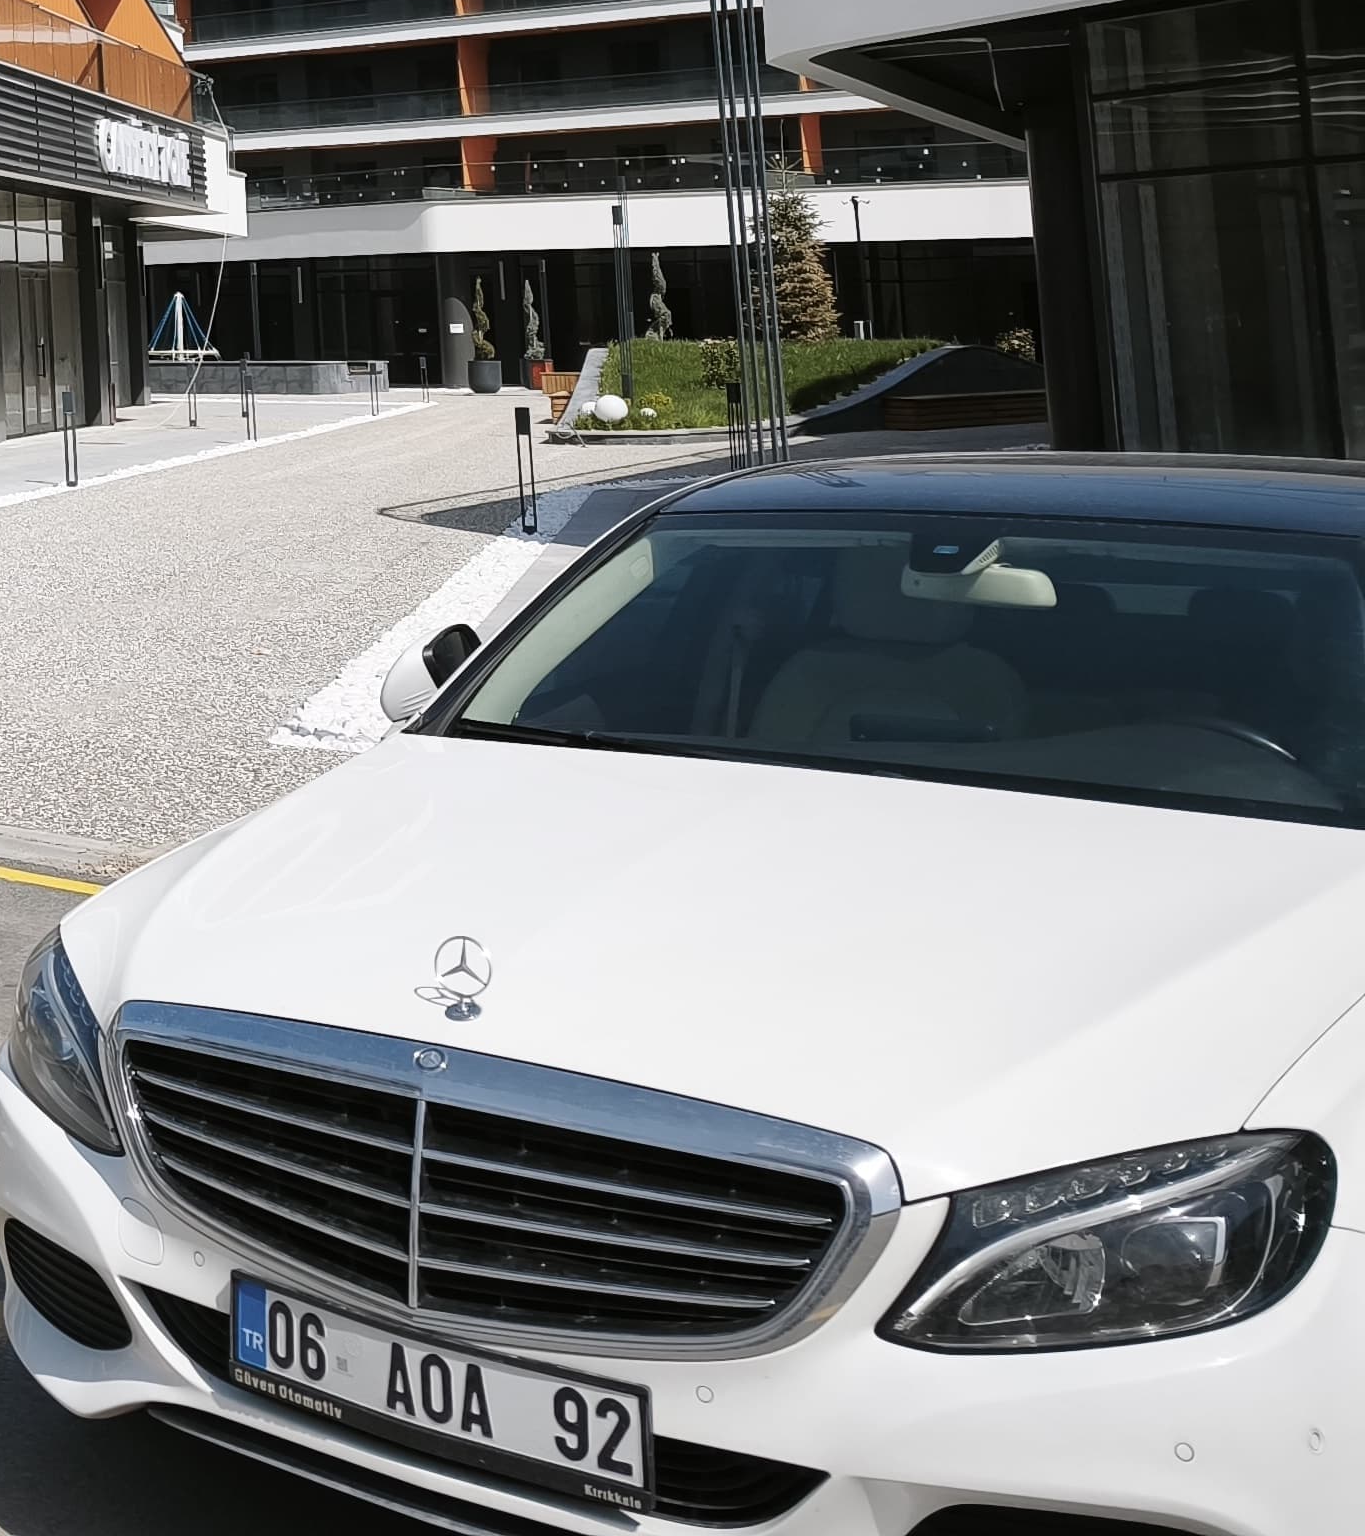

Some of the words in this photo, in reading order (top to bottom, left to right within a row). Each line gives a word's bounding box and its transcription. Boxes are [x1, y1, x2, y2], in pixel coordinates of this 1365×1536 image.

[241, 1327, 264, 1353] TR
[234, 1368, 276, 1395] Güven
[279, 1385, 342, 1420] Otomotiv
[269, 1300, 326, 1381] 06
[386, 1341, 494, 1439] AOA
[553, 1386, 633, 1477] 92
